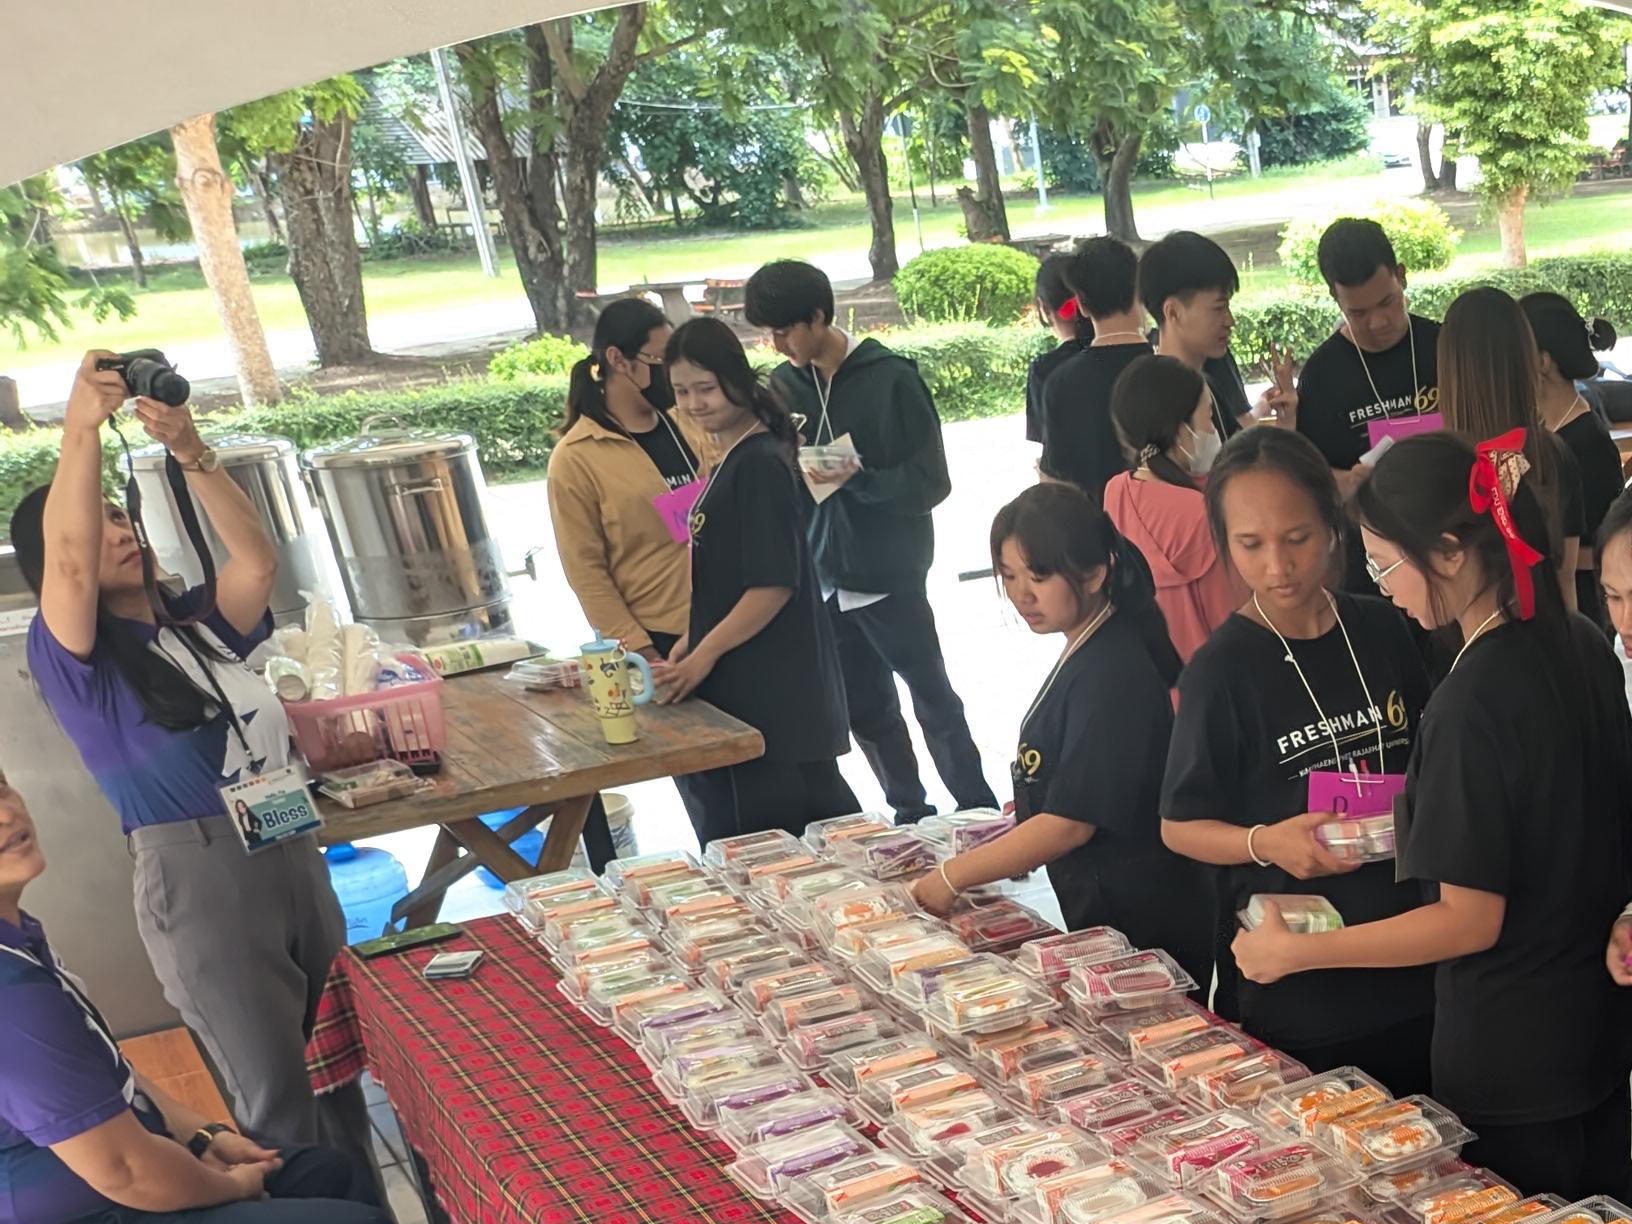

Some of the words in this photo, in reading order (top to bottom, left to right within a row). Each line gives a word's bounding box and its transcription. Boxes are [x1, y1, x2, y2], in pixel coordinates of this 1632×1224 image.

[1348, 394, 1412, 423] FRESHMAN
[1276, 705, 1384, 755] FRESHMAN
[262, 804, 309, 829] Bless
